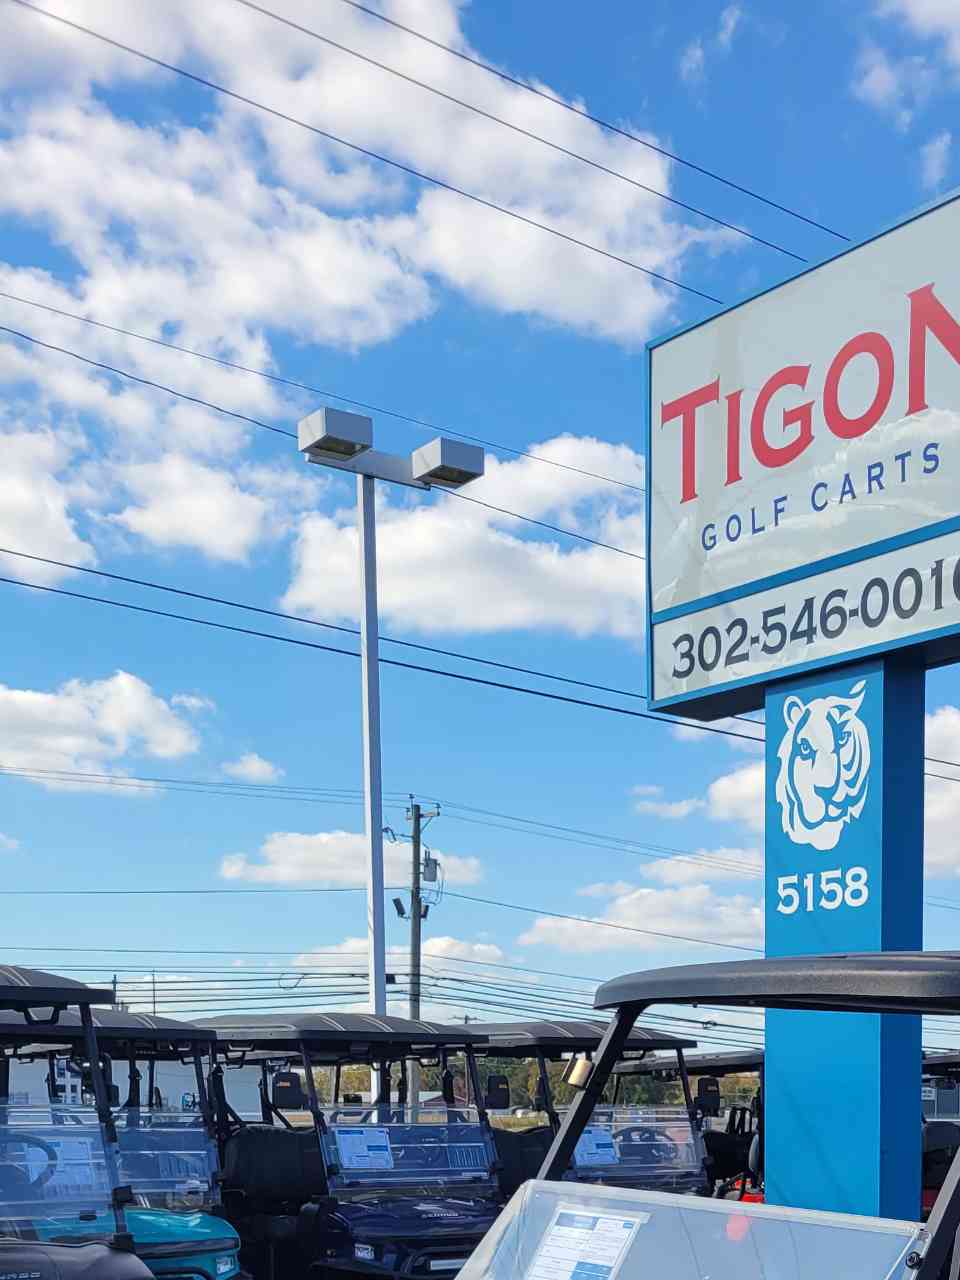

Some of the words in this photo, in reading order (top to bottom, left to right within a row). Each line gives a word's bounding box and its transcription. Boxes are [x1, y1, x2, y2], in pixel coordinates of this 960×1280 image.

[701, 496, 788, 551] GOLF
[810, 442, 940, 512] CARTS
[776, 866, 869, 914] 5158
